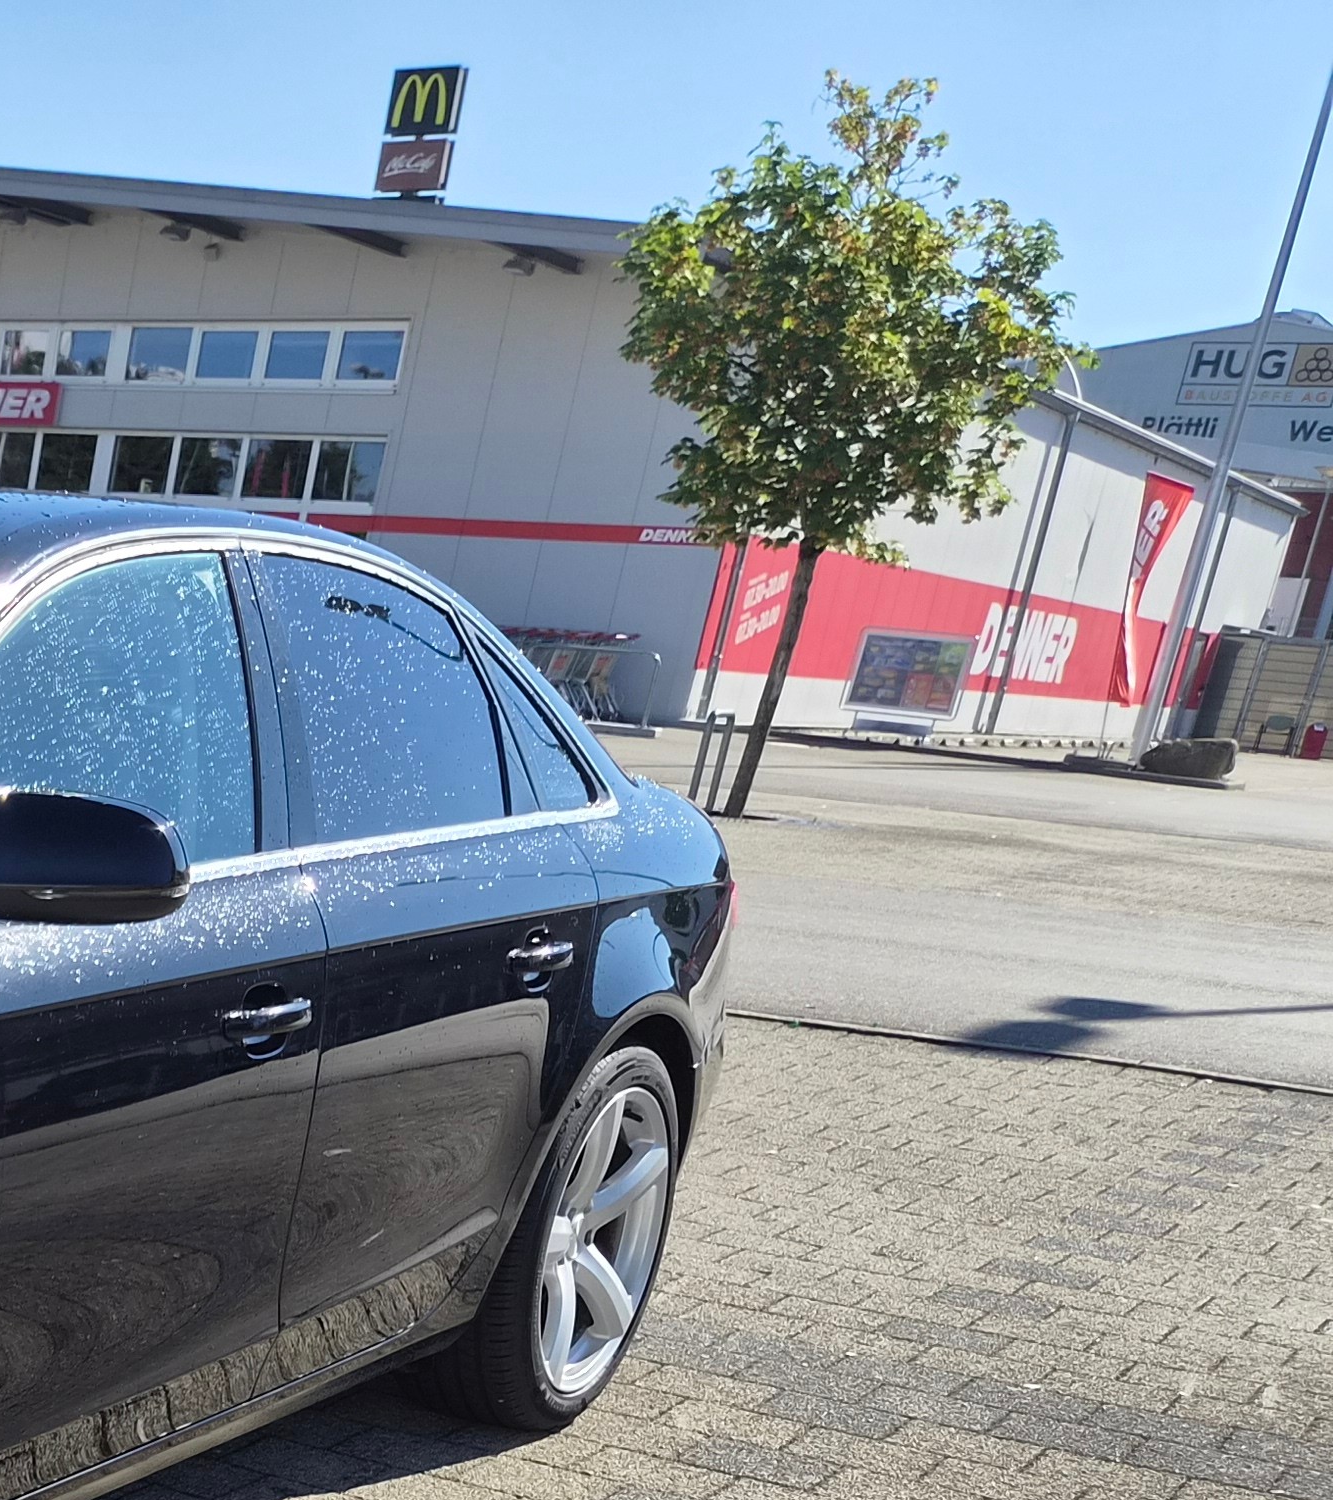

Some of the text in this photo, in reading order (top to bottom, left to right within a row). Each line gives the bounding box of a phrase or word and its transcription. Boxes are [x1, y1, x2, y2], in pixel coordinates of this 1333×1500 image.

[1190, 349, 1287, 379] HUG
[1301, 391, 1328, 403] AG
[969, 602, 1078, 684] DENNER
